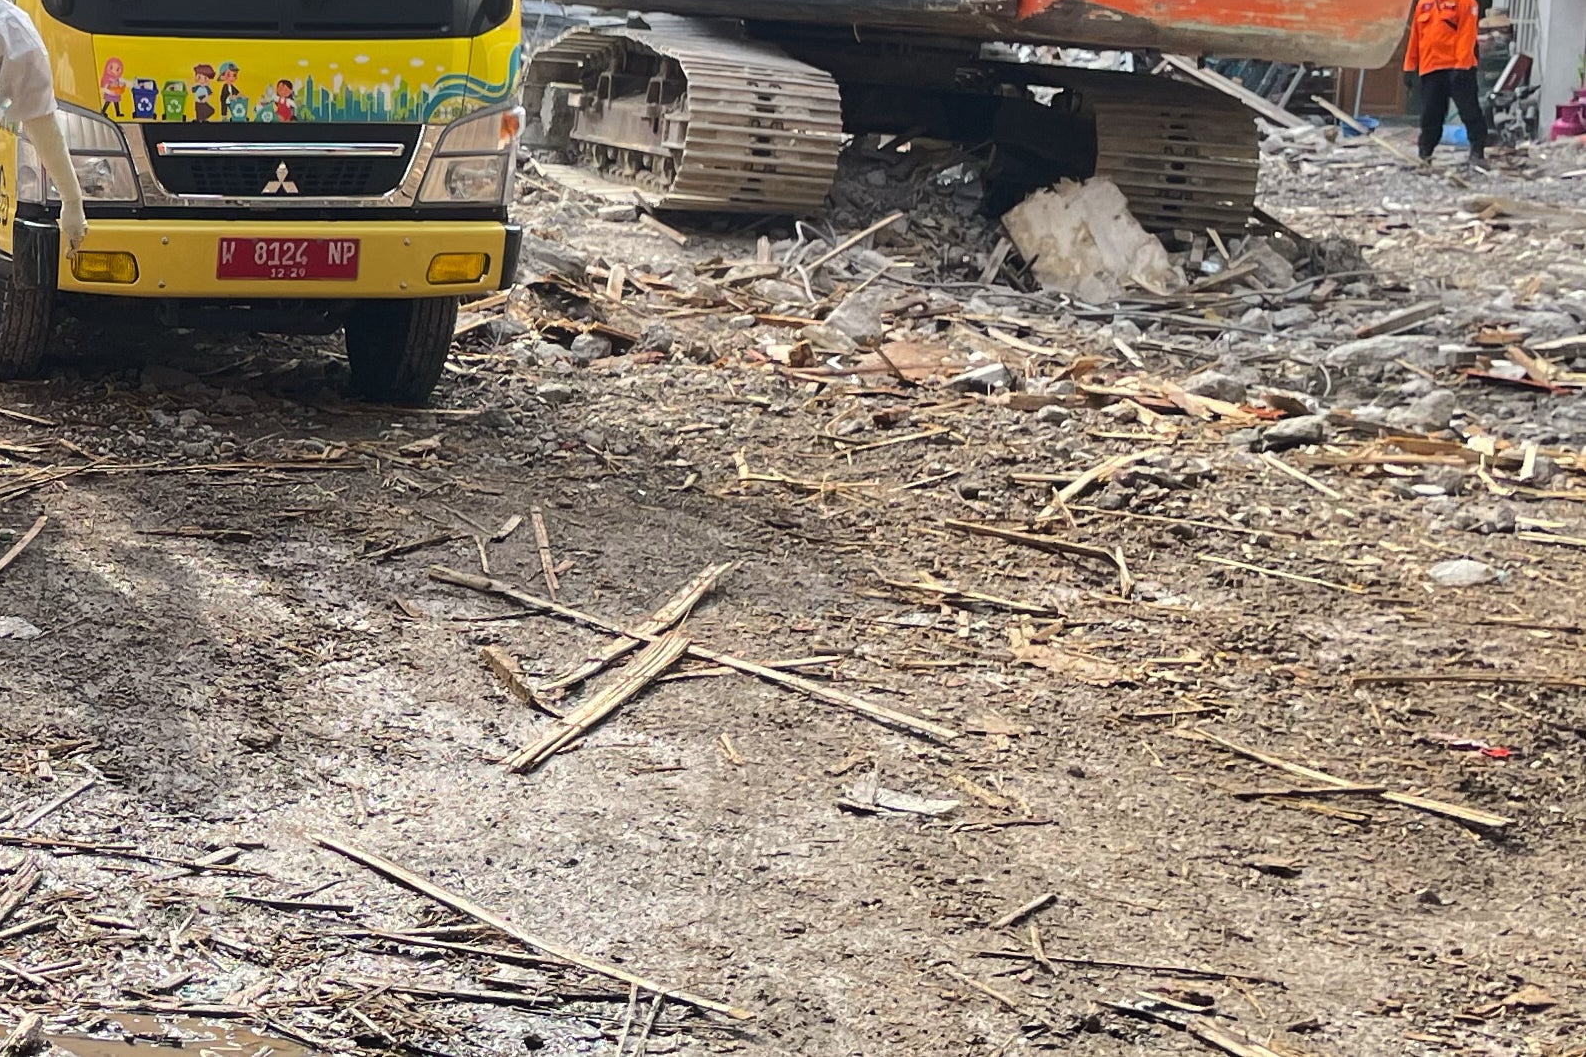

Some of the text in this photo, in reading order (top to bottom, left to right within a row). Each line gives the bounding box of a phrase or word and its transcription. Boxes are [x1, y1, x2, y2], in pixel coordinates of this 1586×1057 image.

[222, 241, 356, 266] W 8124 NP
